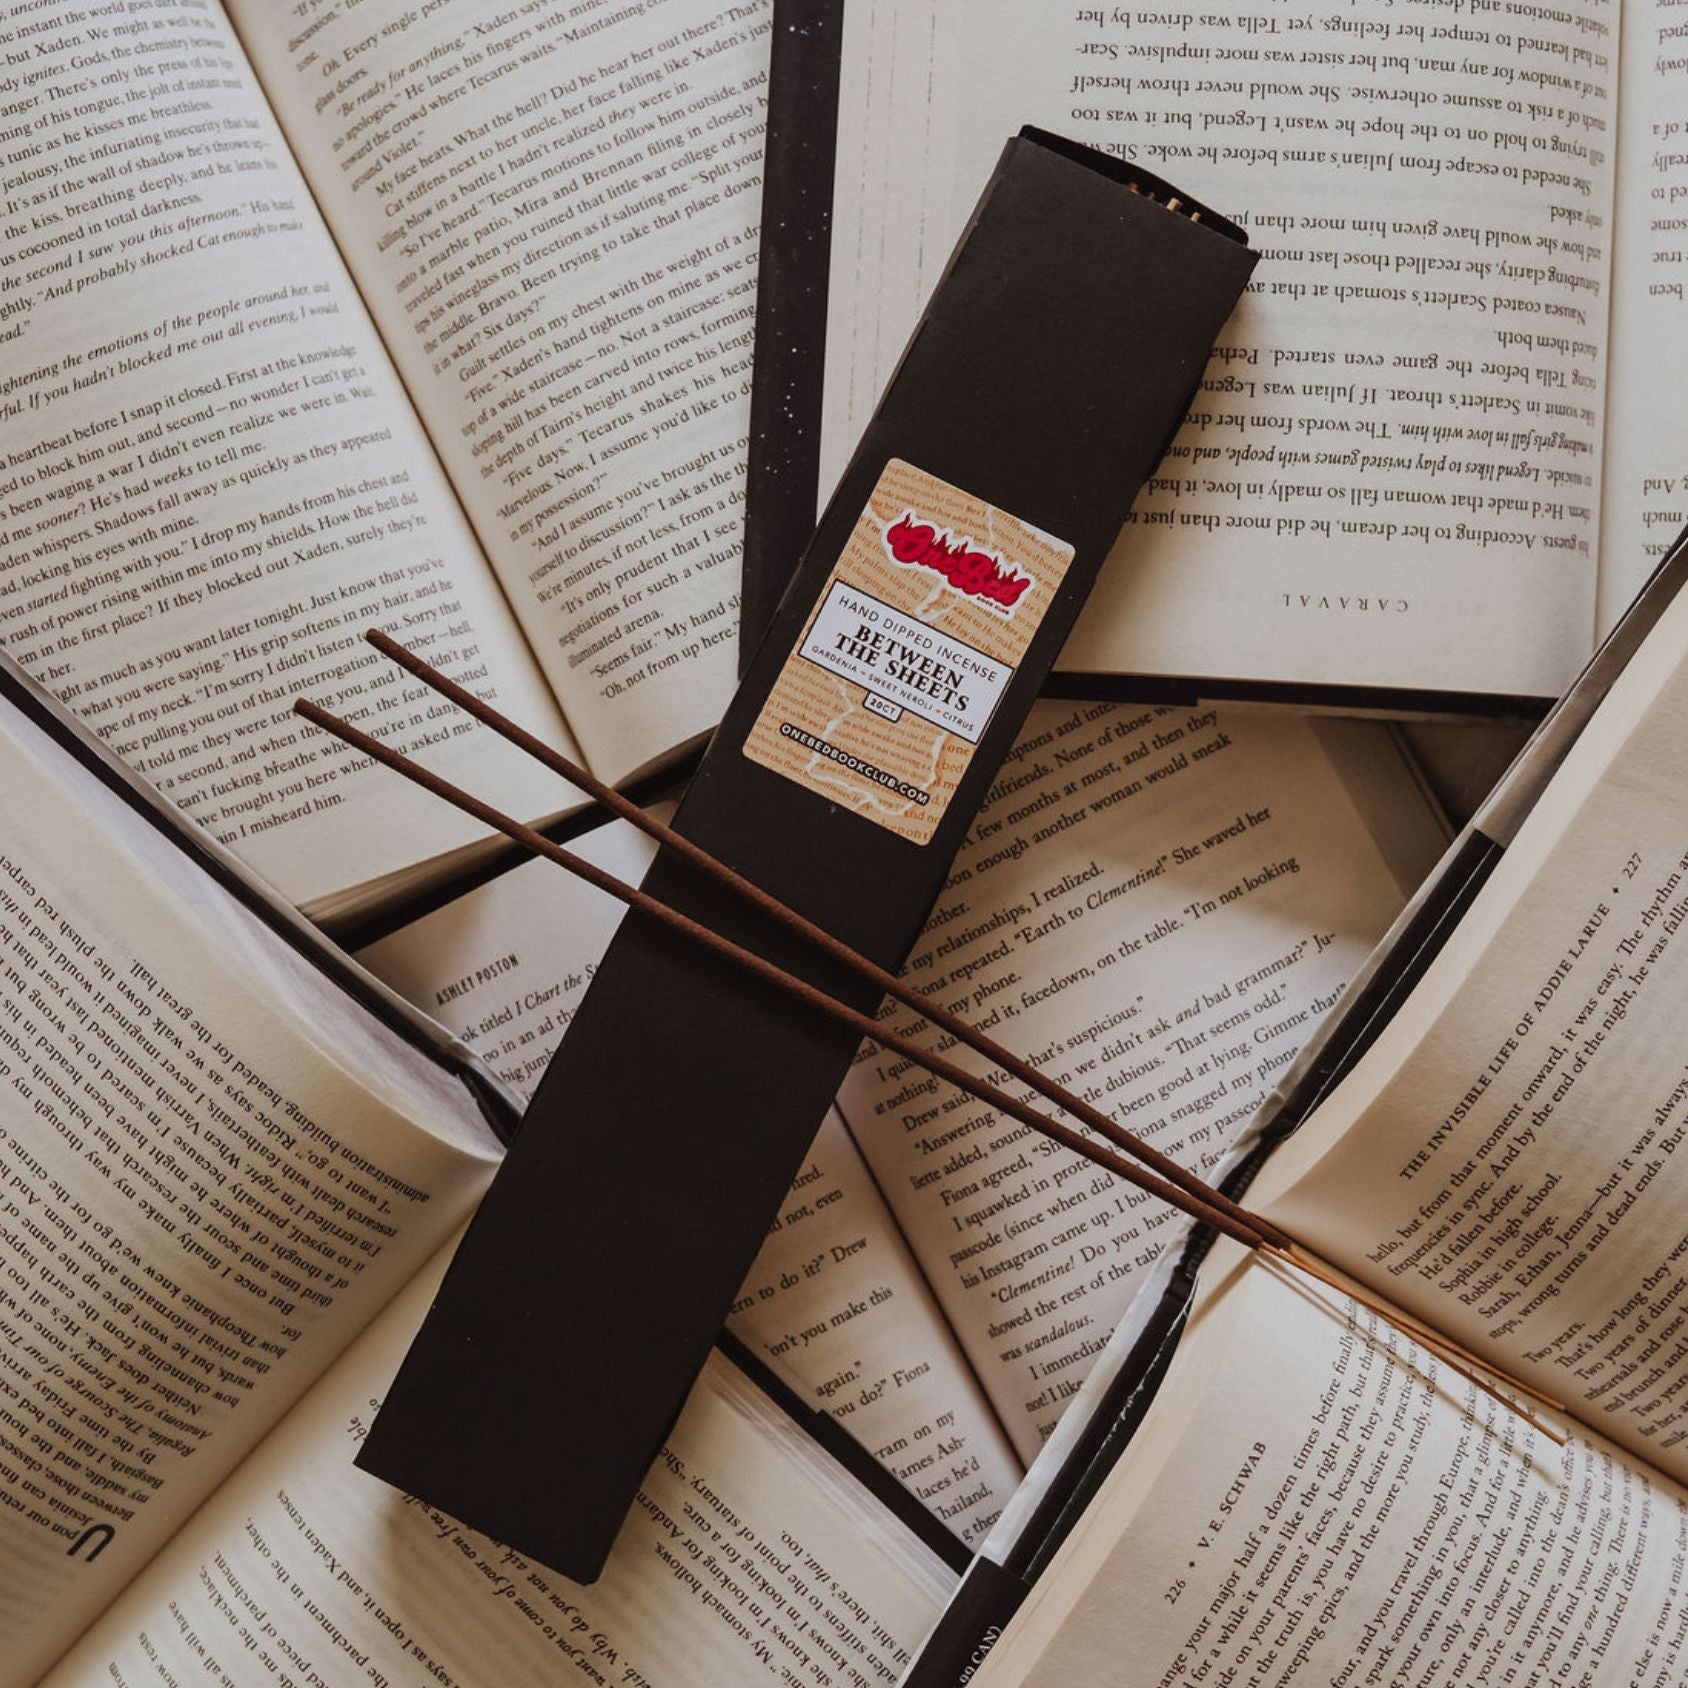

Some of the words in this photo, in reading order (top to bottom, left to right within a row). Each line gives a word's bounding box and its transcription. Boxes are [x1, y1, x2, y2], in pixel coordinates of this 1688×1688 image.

[1069, 75, 1132, 95] herself
[1136, 78, 1190, 98] throw
[1195, 80, 1244, 93] never
[1249, 82, 1304, 101] would
[1070, 108, 1100, 122] too
[1106, 109, 1139, 122] was
[1144, 111, 1157, 127] it
[1163, 112, 1193, 131] but
[1198, 109, 1267, 133] Legend,
[485, 175, 540, 207] Tecarus
[540, 148, 596, 182] motions
[595, 141, 612, 154] to
[612, 121, 656, 148] follow
[656, 108, 686, 127] him
[619, 224, 651, 245] take
[652, 209, 682, 230] that
[683, 193, 721, 220] place
[723, 175, 762, 199] down
[17, 224, 86, 261] cocooned
[87, 222, 103, 236] in
[104, 207, 139, 230] total
[0, 276, 22, 293] the
[25, 253, 73, 284] second
[77, 249, 84, 264] I
[88, 243, 114, 261] saw
[119, 233, 146, 253] you
[149, 224, 174, 240] this
[1215, 413, 1246, 434] her
[1250, 415, 1293, 436] from
[1297, 417, 1351, 436] words
[1354, 420, 1392, 440] The
[35, 501, 86, 533] sooner?
[121, 478, 151, 500] had
[152, 465, 194, 488] weeks
[196, 459, 212, 472] to
[214, 446, 239, 466] tell
[240, 442, 266, 457] me.
[1643, 478, 1676, 497] And
[1143, 507, 1176, 530] just
[1179, 513, 1221, 533] than
[1225, 515, 1272, 530] more
[1276, 518, 1306, 537] did
[1310, 519, 1331, 539] he
[1336, 519, 1398, 542] dream,
[1642, 511, 1683, 529] much
[20, 562, 72, 589] locking
[71, 552, 93, 570] his
[94, 542, 126, 562] eyes
[126, 527, 158, 548] with
[160, 516, 200, 537] mine.
[1282, 593, 1409, 612] CARAVAL
[838, 595, 880, 623] HAND
[882, 617, 933, 650] DIPPED
[936, 644, 998, 683] INCENSE
[853, 624, 965, 689] BETWEEN
[625, 669, 647, 688] not
[646, 653, 680, 676] from
[680, 643, 700, 659] up
[834, 632, 881, 668] THE
[884, 659, 970, 712] SHEETS
[811, 644, 858, 673] GARDENIA
[868, 673, 899, 693] SWEET
[899, 689, 933, 711] NEROLI
[941, 711, 975, 732] CITRUS
[869, 697, 897, 716] 20CT
[778, 720, 931, 808] ONEBEDBOOKCLUB.COM
[948, 939, 1016, 983] repeated.
[1066, 906, 1084, 921] to
[1171, 845, 1202, 866] She
[1201, 816, 1247, 850] waved
[1244, 807, 1271, 828] her
[1217, 885, 1245, 906] not
[1242, 857, 1301, 892] looking
[911, 951, 934, 970] my
[936, 903, 1033, 958] relationships,
[1028, 890, 1043, 908] I
[1042, 860, 1105, 903] realized.
[129, 958, 159, 992] hall.
[435, 975, 475, 1007] ASHLEY
[475, 952, 519, 985] POSTON
[116, 979, 152, 1017] down
[156, 986, 194, 1021] great
[479, 1005, 514, 1034] titled
[514, 1000, 523, 1017] I
[523, 983, 561, 1011] Chart
[563, 973, 583, 992] the
[1399, 1149, 1431, 1180] THE
[1426, 1074, 1493, 1152] INVISIBLE
[1487, 1037, 1520, 1075] LIFE
[1514, 1012, 1535, 1037] OF
[1533, 959, 1574, 1013] ADDIE
[1567, 903, 1611, 960] LARUE
[1622, 852, 1642, 880] 227
[151, 1016, 183, 1050] walk
[190, 1020, 213, 1044] the
[1521, 1045, 1569, 1102] onward,
[1564, 1027, 1578, 1042] it
[1574, 997, 1599, 1026] was
[1596, 962, 1624, 996] easy.
[185, 1049, 205, 1071] we
[211, 1041, 235, 1065] for
[206, 1068, 225, 1086] as
[231, 1060, 283, 1109] headed
[224, 1084, 255, 1113] says
[254, 1111, 297, 1151] Ridoc
[1438, 1259, 1484, 1294] Sophia
[1476, 1246, 1497, 1261] in
[1489, 1217, 1524, 1247] high
[1520, 1172, 1563, 1218] school.
[1447, 1224, 1486, 1257] fallen
[1477, 1184, 1524, 1225] before.
[978, 1242, 1050, 1282] Instagram
[1050, 1222, 1089, 1247] came
[1090, 1211, 1115, 1228] up.
[1113, 1198, 1126, 1214] I
[779, 1272, 800, 1290] do
[829, 1236, 867, 1264] Drew
[1457, 1271, 1504, 1306] Robbie
[1496, 1258, 1518, 1273] in
[1514, 1215, 1560, 1259] college.
[1164, 1579, 1187, 1605] 226
[1196, 1536, 1215, 1548] V.
[1208, 1519, 1225, 1533] E.
[1219, 1441, 1267, 1515] SCHWAB
[304, 1528, 342, 1574] Xaden
[654, 1541, 703, 1595] hollows.
[1451, 1652, 1473, 1679] not
[1468, 1622, 1491, 1652] any
[1483, 1577, 1512, 1622] closer
[1506, 1559, 1520, 1576] to
[1516, 1491, 1550, 1558] anything.
[701, 1589, 753, 1641] stomach
[750, 1639, 774, 1665] My
